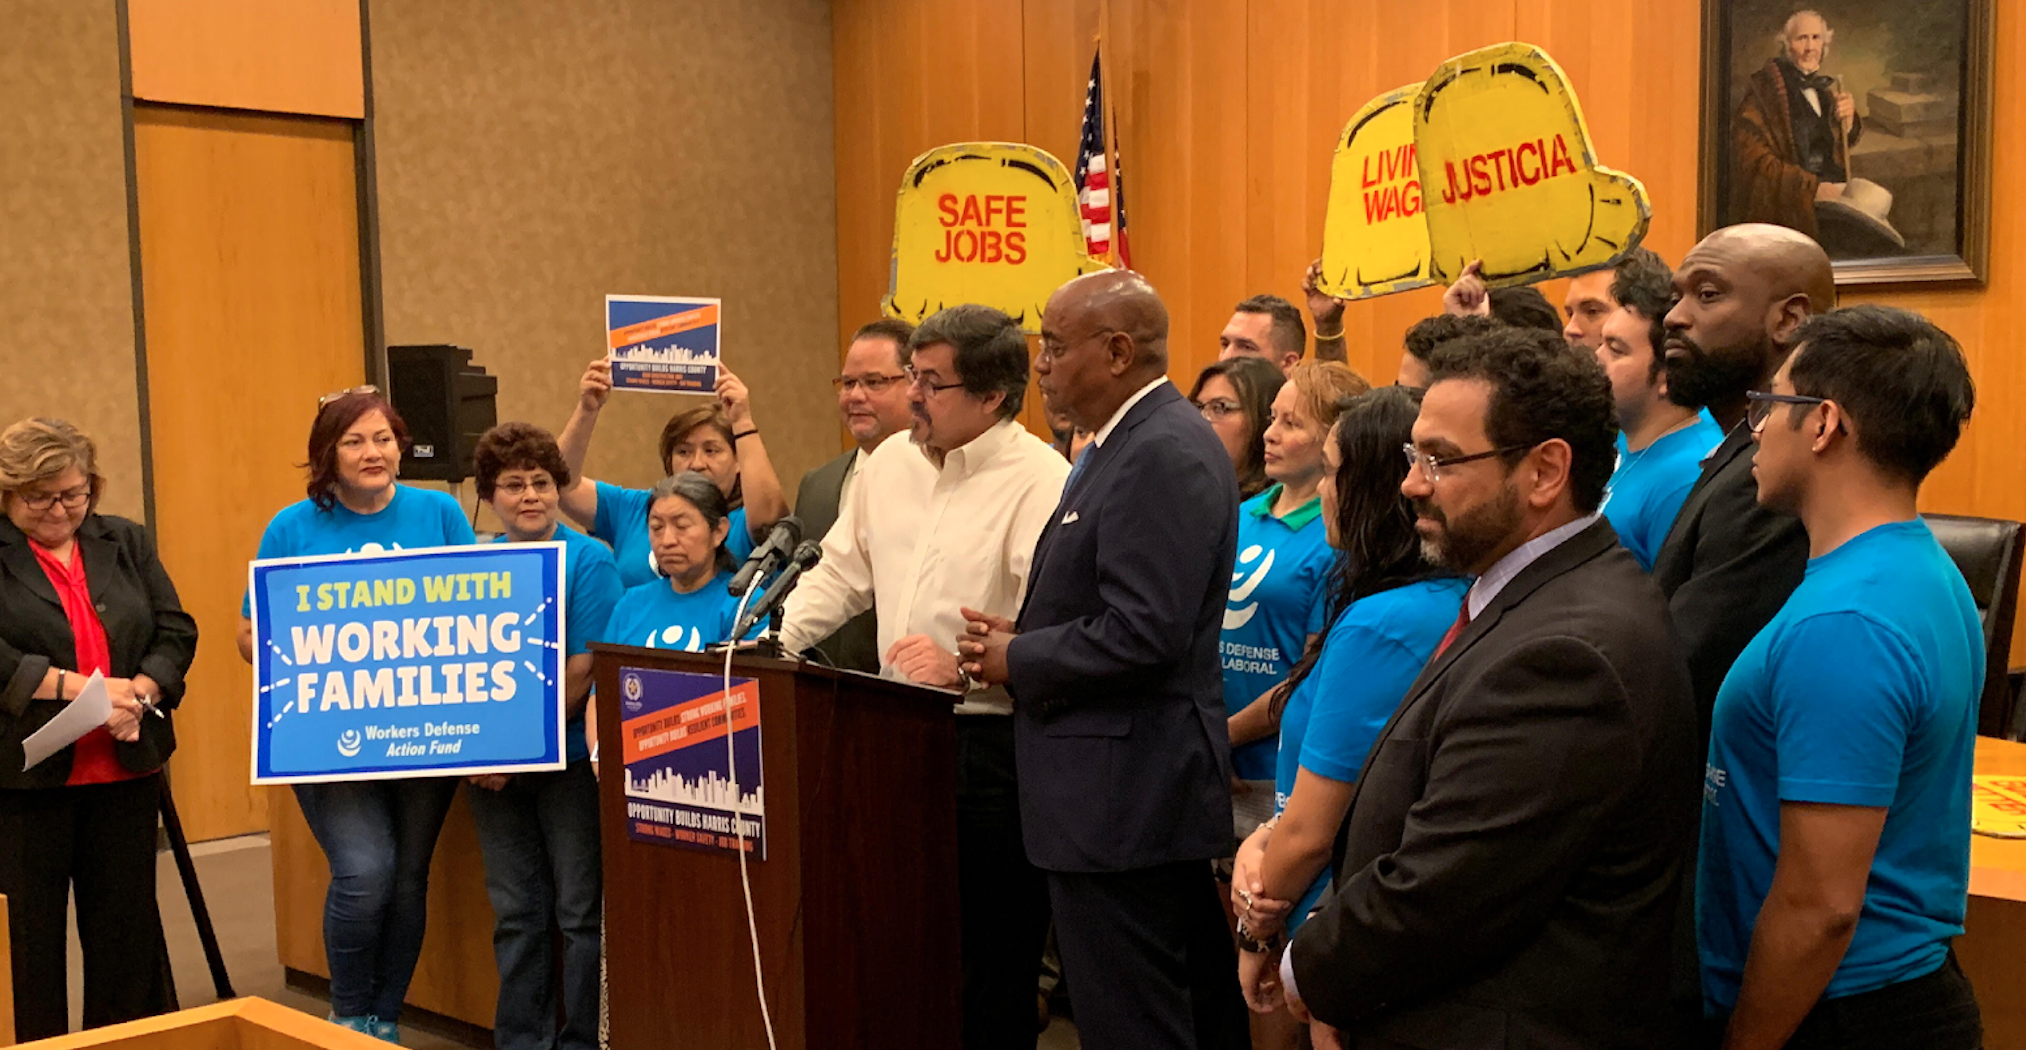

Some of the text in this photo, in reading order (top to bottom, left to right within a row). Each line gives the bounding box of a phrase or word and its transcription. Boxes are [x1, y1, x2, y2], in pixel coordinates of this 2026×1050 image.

[1442, 133, 1577, 205] JUSTICIA
[938, 193, 1027, 228] SAFE
[1364, 180, 1425, 226] WAG
[935, 229, 1027, 265] JOBS
[296, 571, 512, 612] I STAND WITH
[291, 611, 521, 665] WORKING
[1226, 641, 1280, 661] DEFENSE
[1222, 656, 1278, 675] LABORAL
[297, 660, 517, 714] FAMILIES
[365, 721, 480, 740] Workers Defense
[386, 739, 462, 757] Action Fund
[628, 801, 761, 838] OPPORTUNITY BUILDS HARRIS CUNTY
